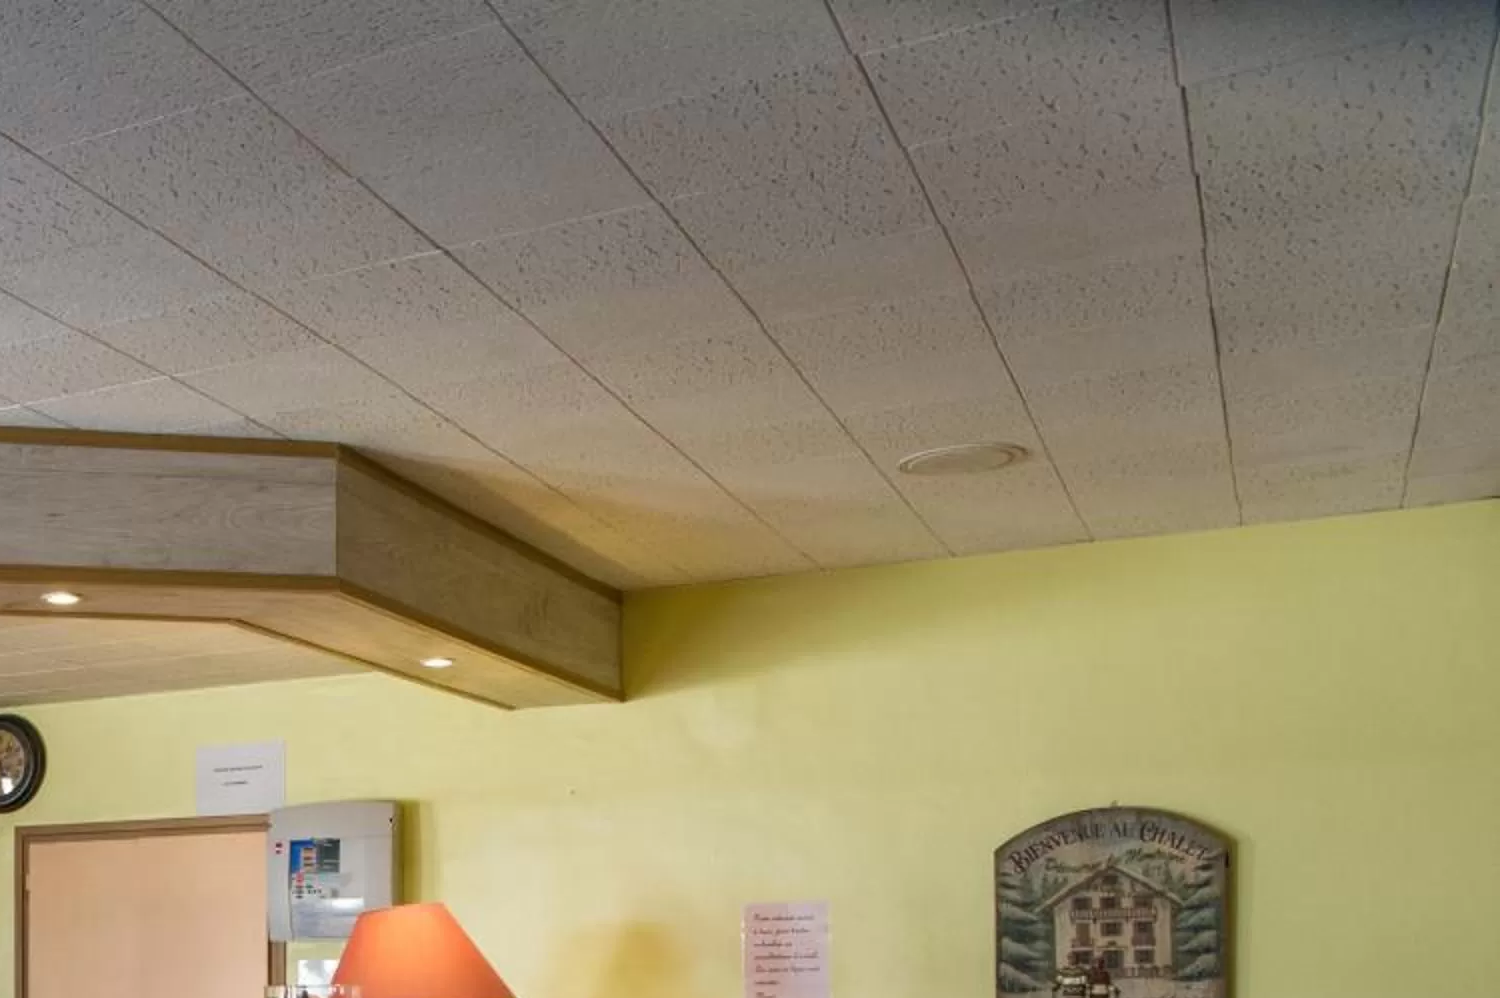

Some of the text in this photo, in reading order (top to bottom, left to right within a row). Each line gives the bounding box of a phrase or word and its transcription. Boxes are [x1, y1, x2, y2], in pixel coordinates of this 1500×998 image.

[1008, 821, 1208, 873] BIENVENUE AU CHALET
